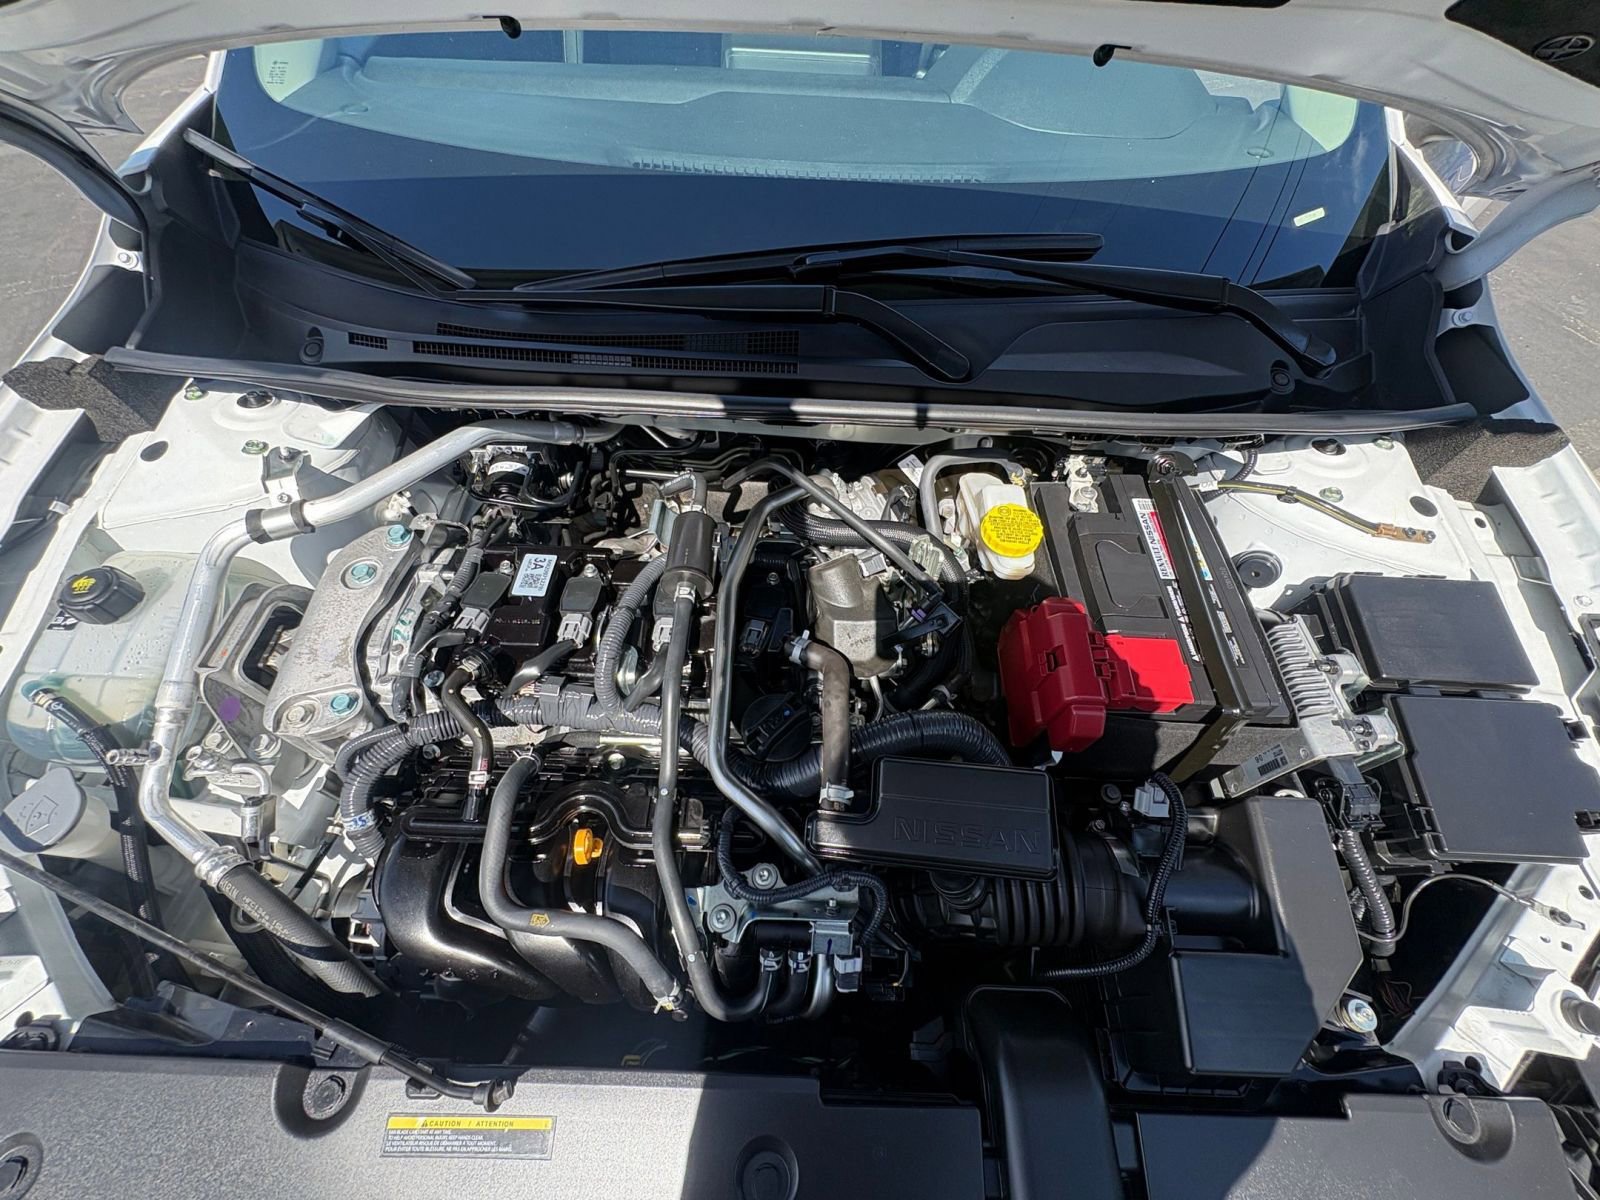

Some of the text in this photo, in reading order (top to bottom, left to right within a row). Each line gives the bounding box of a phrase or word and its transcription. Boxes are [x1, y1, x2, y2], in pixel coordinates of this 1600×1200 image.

[1139, 512, 1157, 545] NISSAN
[531, 557, 547, 571] 3A
[1152, 546, 1170, 578] RENAULT
[894, 815, 1041, 854] NISSAN
[429, 1119, 461, 1127] CAUTION
[475, 1119, 514, 1128] ATTENTION
